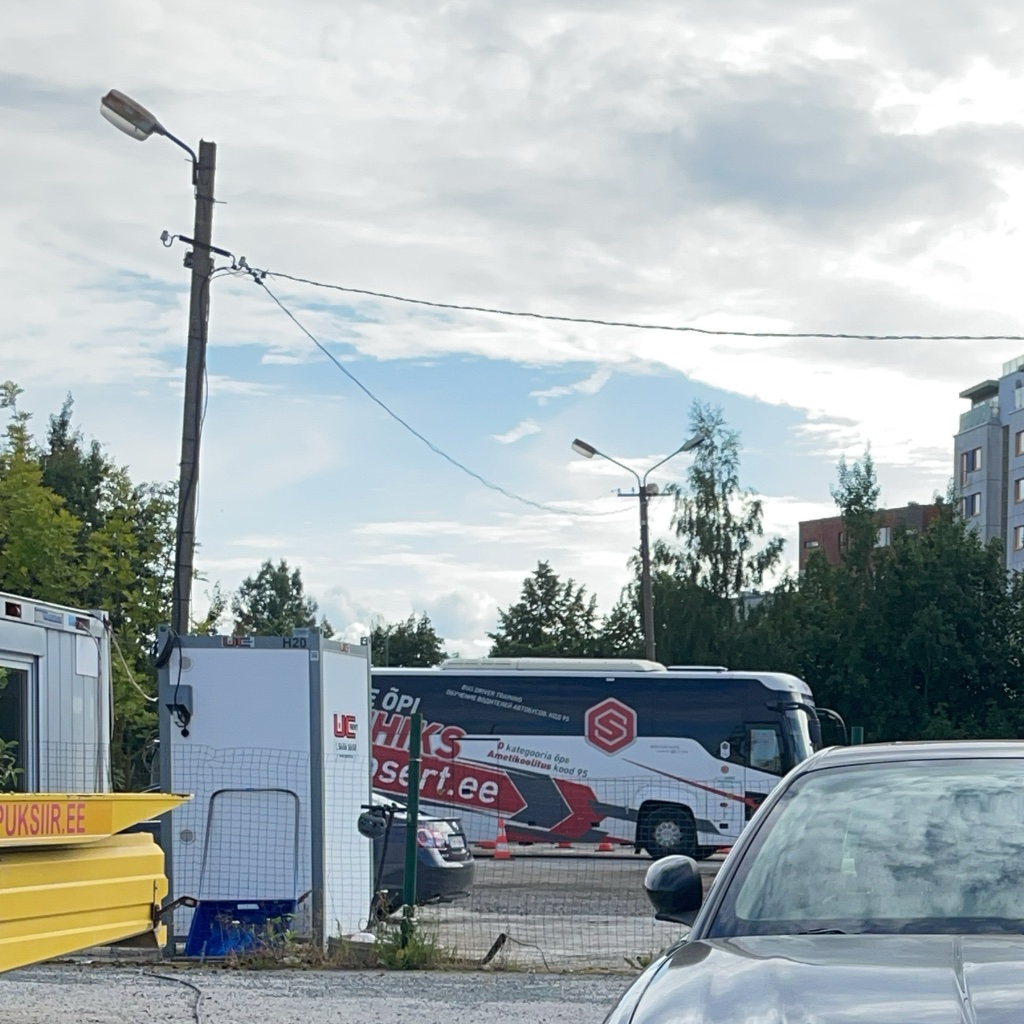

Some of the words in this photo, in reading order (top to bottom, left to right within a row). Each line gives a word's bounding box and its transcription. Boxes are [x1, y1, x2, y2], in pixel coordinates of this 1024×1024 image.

[382, 687, 420, 714] ÕPI
[461, 684, 474, 693] BUS
[474, 687, 495, 697] DRIVER
[371, 709, 467, 760] HIKS
[487, 750, 551, 770] Ametikoolitus
[553, 765, 575, 775] kood
[577, 769, 589, 778] 95
[497, 742, 505, 750] D
[506, 744, 552, 760] kategooria
[554, 753, 570, 764] õpe
